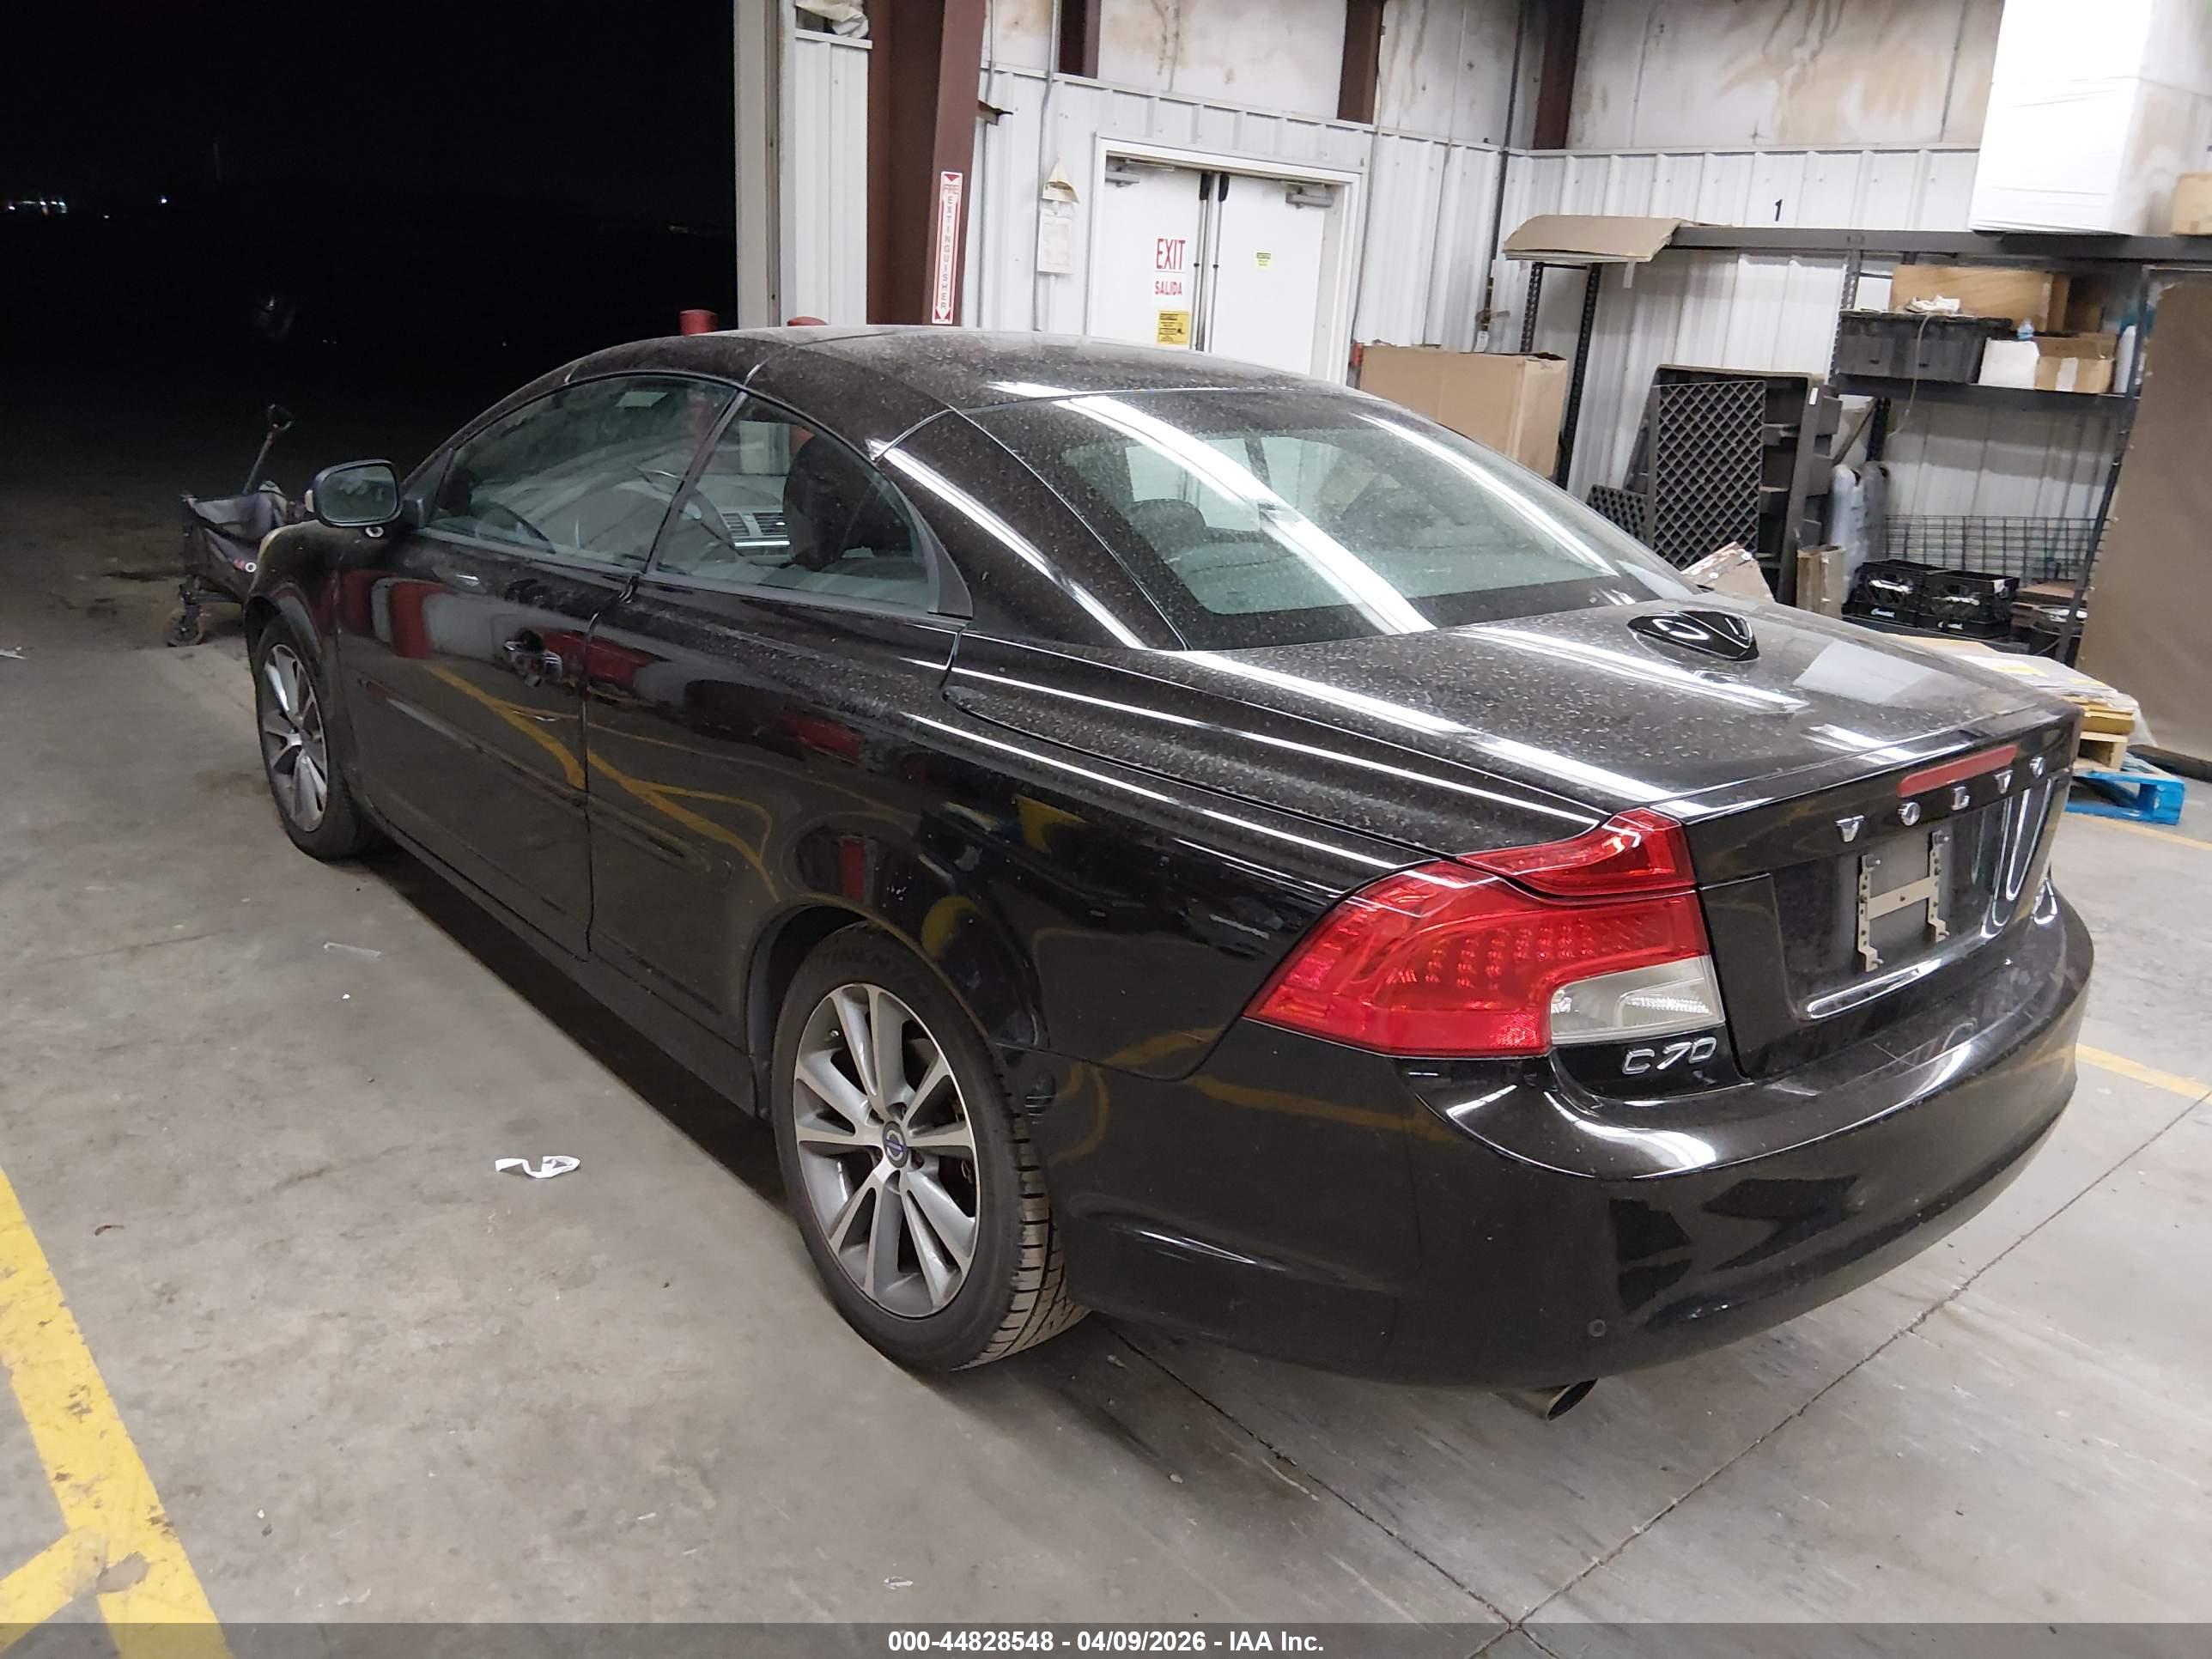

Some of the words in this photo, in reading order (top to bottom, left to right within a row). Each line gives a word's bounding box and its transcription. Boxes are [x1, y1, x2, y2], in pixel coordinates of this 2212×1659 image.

[1774, 198, 1784, 222] 1
[940, 196, 954, 309] EXTINGUISHER
[1156, 238, 1186, 270] EXIT
[1154, 280, 1182, 295] SALIDA
[1834, 756, 2046, 842] VOLVO
[1622, 1036, 1717, 1075] C70
